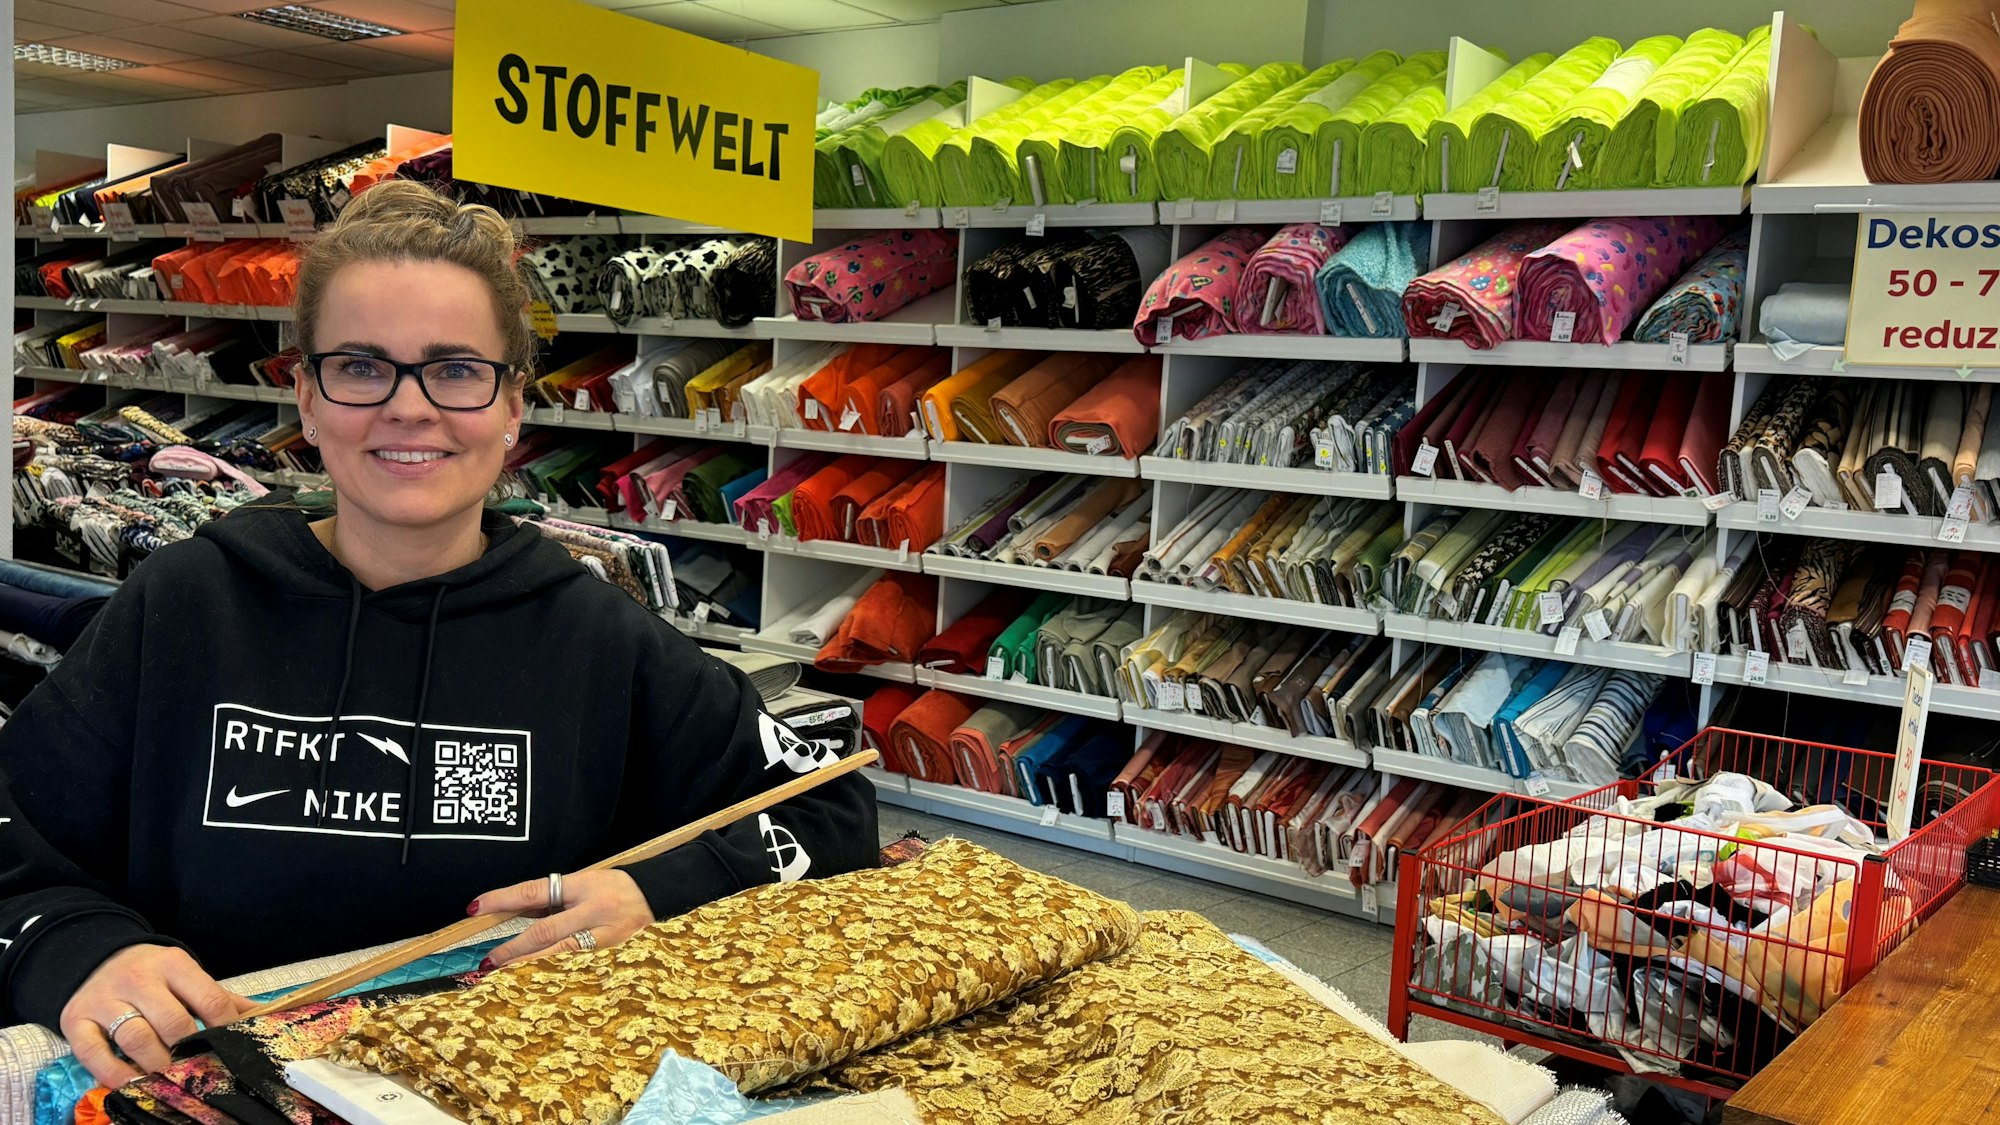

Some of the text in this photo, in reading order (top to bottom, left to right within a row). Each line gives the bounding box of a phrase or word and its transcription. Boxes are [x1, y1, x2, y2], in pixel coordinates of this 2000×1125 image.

[494, 53, 789, 181] STOFFWELT
[1887, 269, 1938, 297] 50
[1883, 320, 2000, 349] reduz
[224, 720, 346, 762] RTFKT
[303, 788, 401, 823] NIKE
